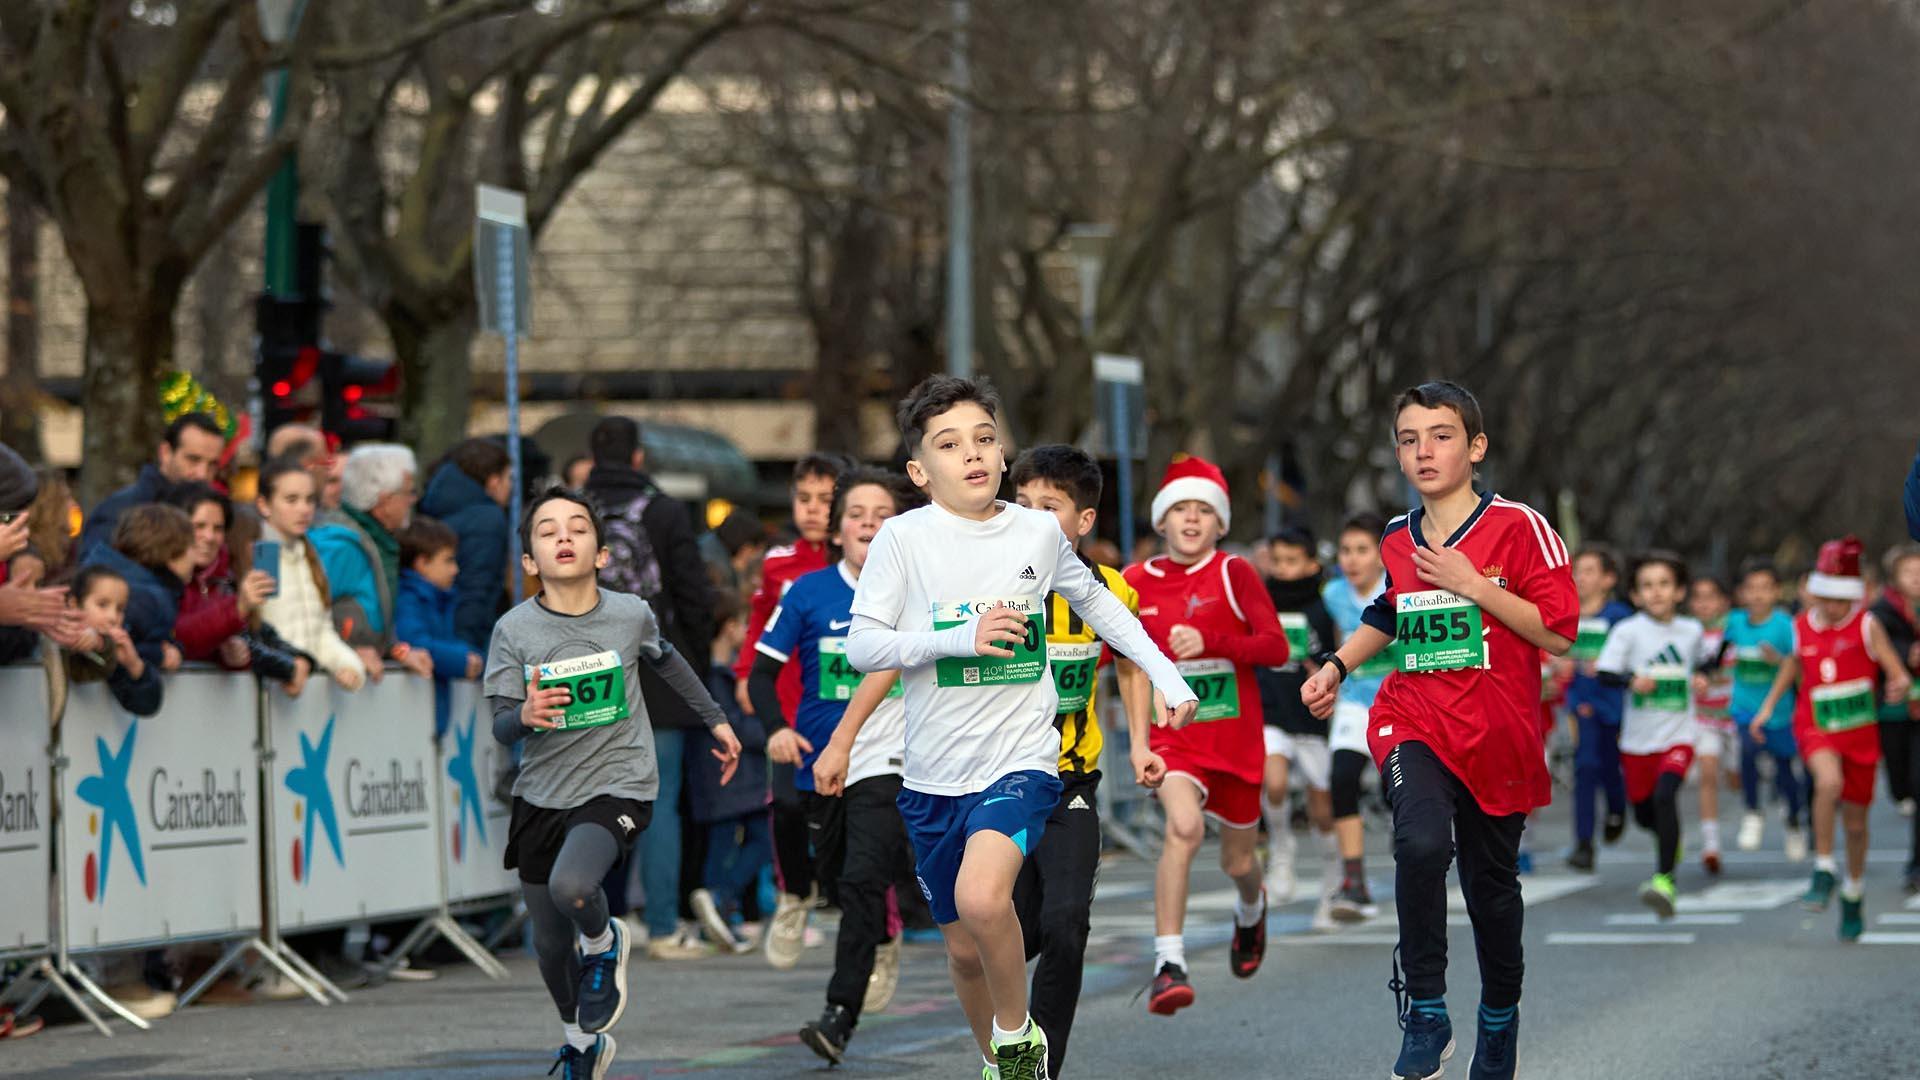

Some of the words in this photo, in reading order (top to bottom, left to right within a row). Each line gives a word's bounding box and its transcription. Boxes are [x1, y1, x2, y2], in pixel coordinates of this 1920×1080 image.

[975, 600, 1031, 614] CaBank
[1413, 593, 1461, 608] CaixaBank
[1398, 612, 1471, 645] 4455
[1048, 646, 1089, 657] CaixaBank
[554, 658, 603, 674] CaixaBank
[1007, 672, 1037, 680] LASTERKETA
[344, 758, 429, 817] CaixaBank
[151, 767, 248, 831] CaixaBank
